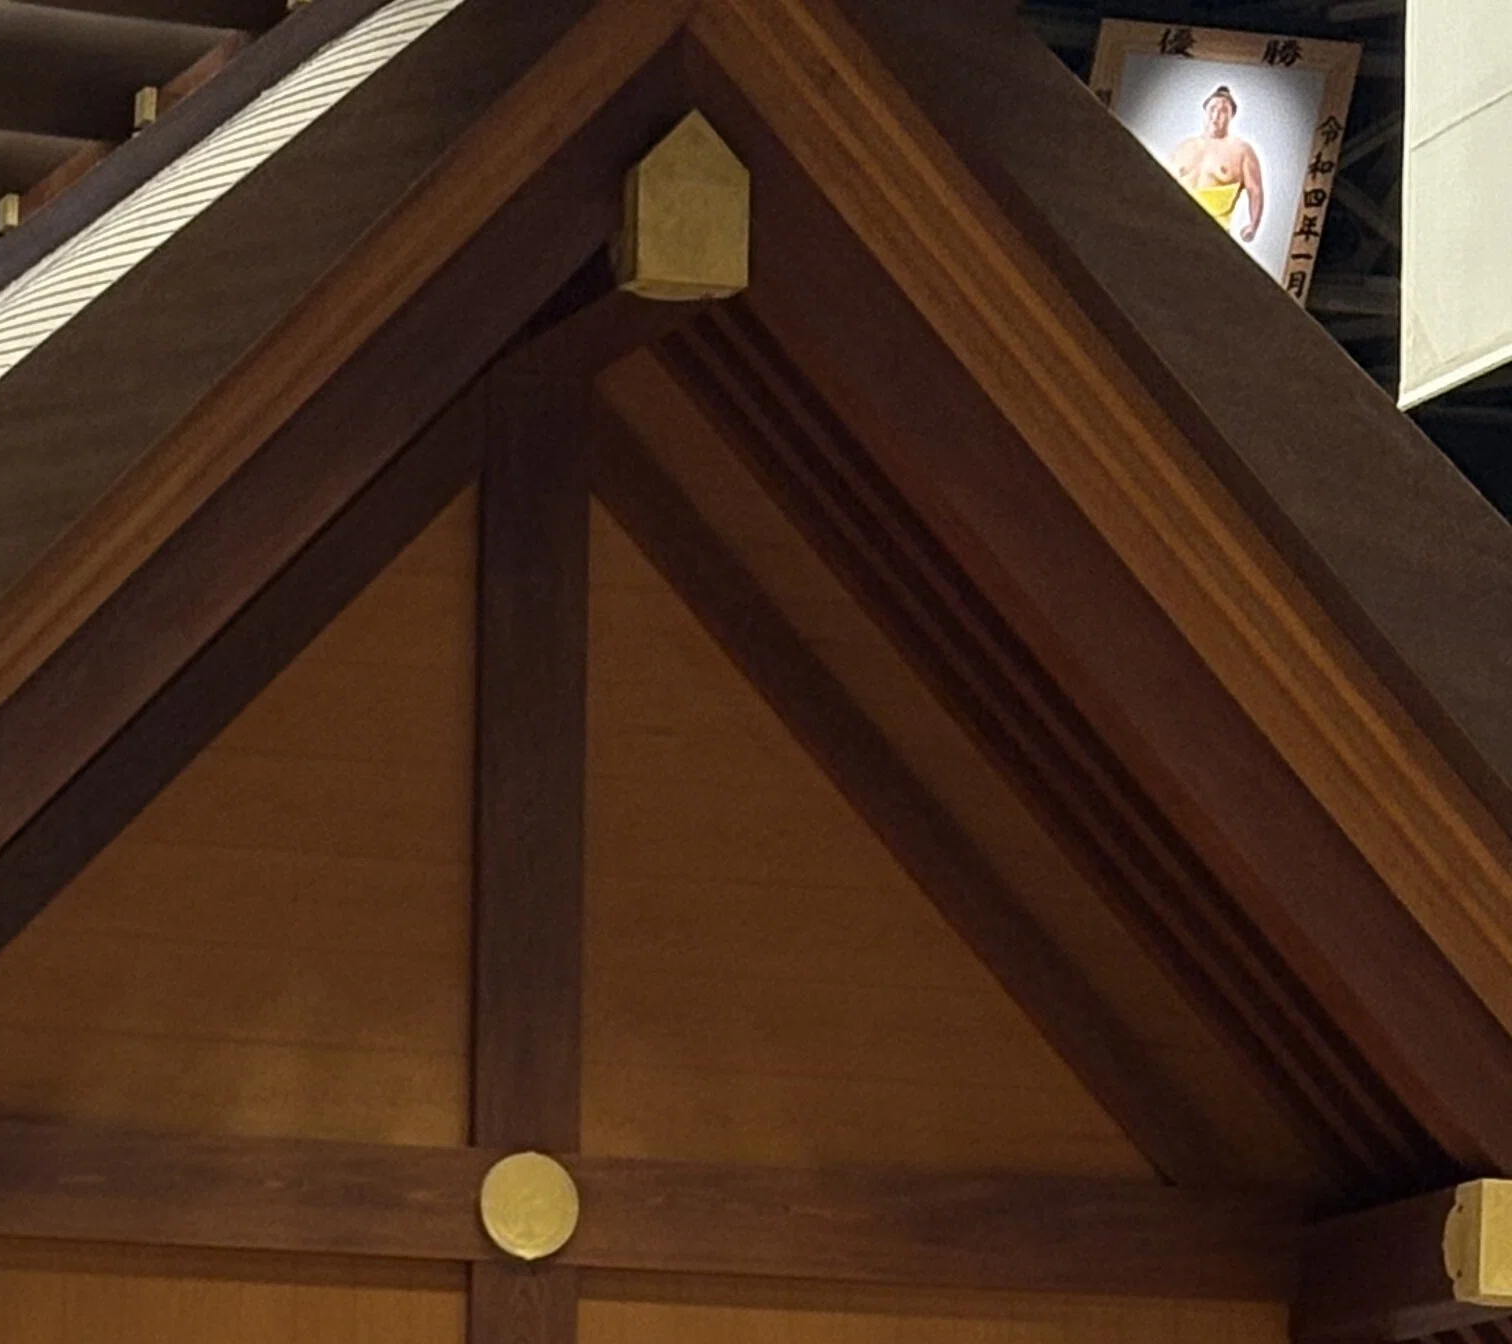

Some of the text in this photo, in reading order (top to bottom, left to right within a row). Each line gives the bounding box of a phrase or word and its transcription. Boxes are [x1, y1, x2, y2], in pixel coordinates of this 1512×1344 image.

[1158, 28, 1303, 67] 優勝
[1286, 114, 1343, 297] 令和四年一月
